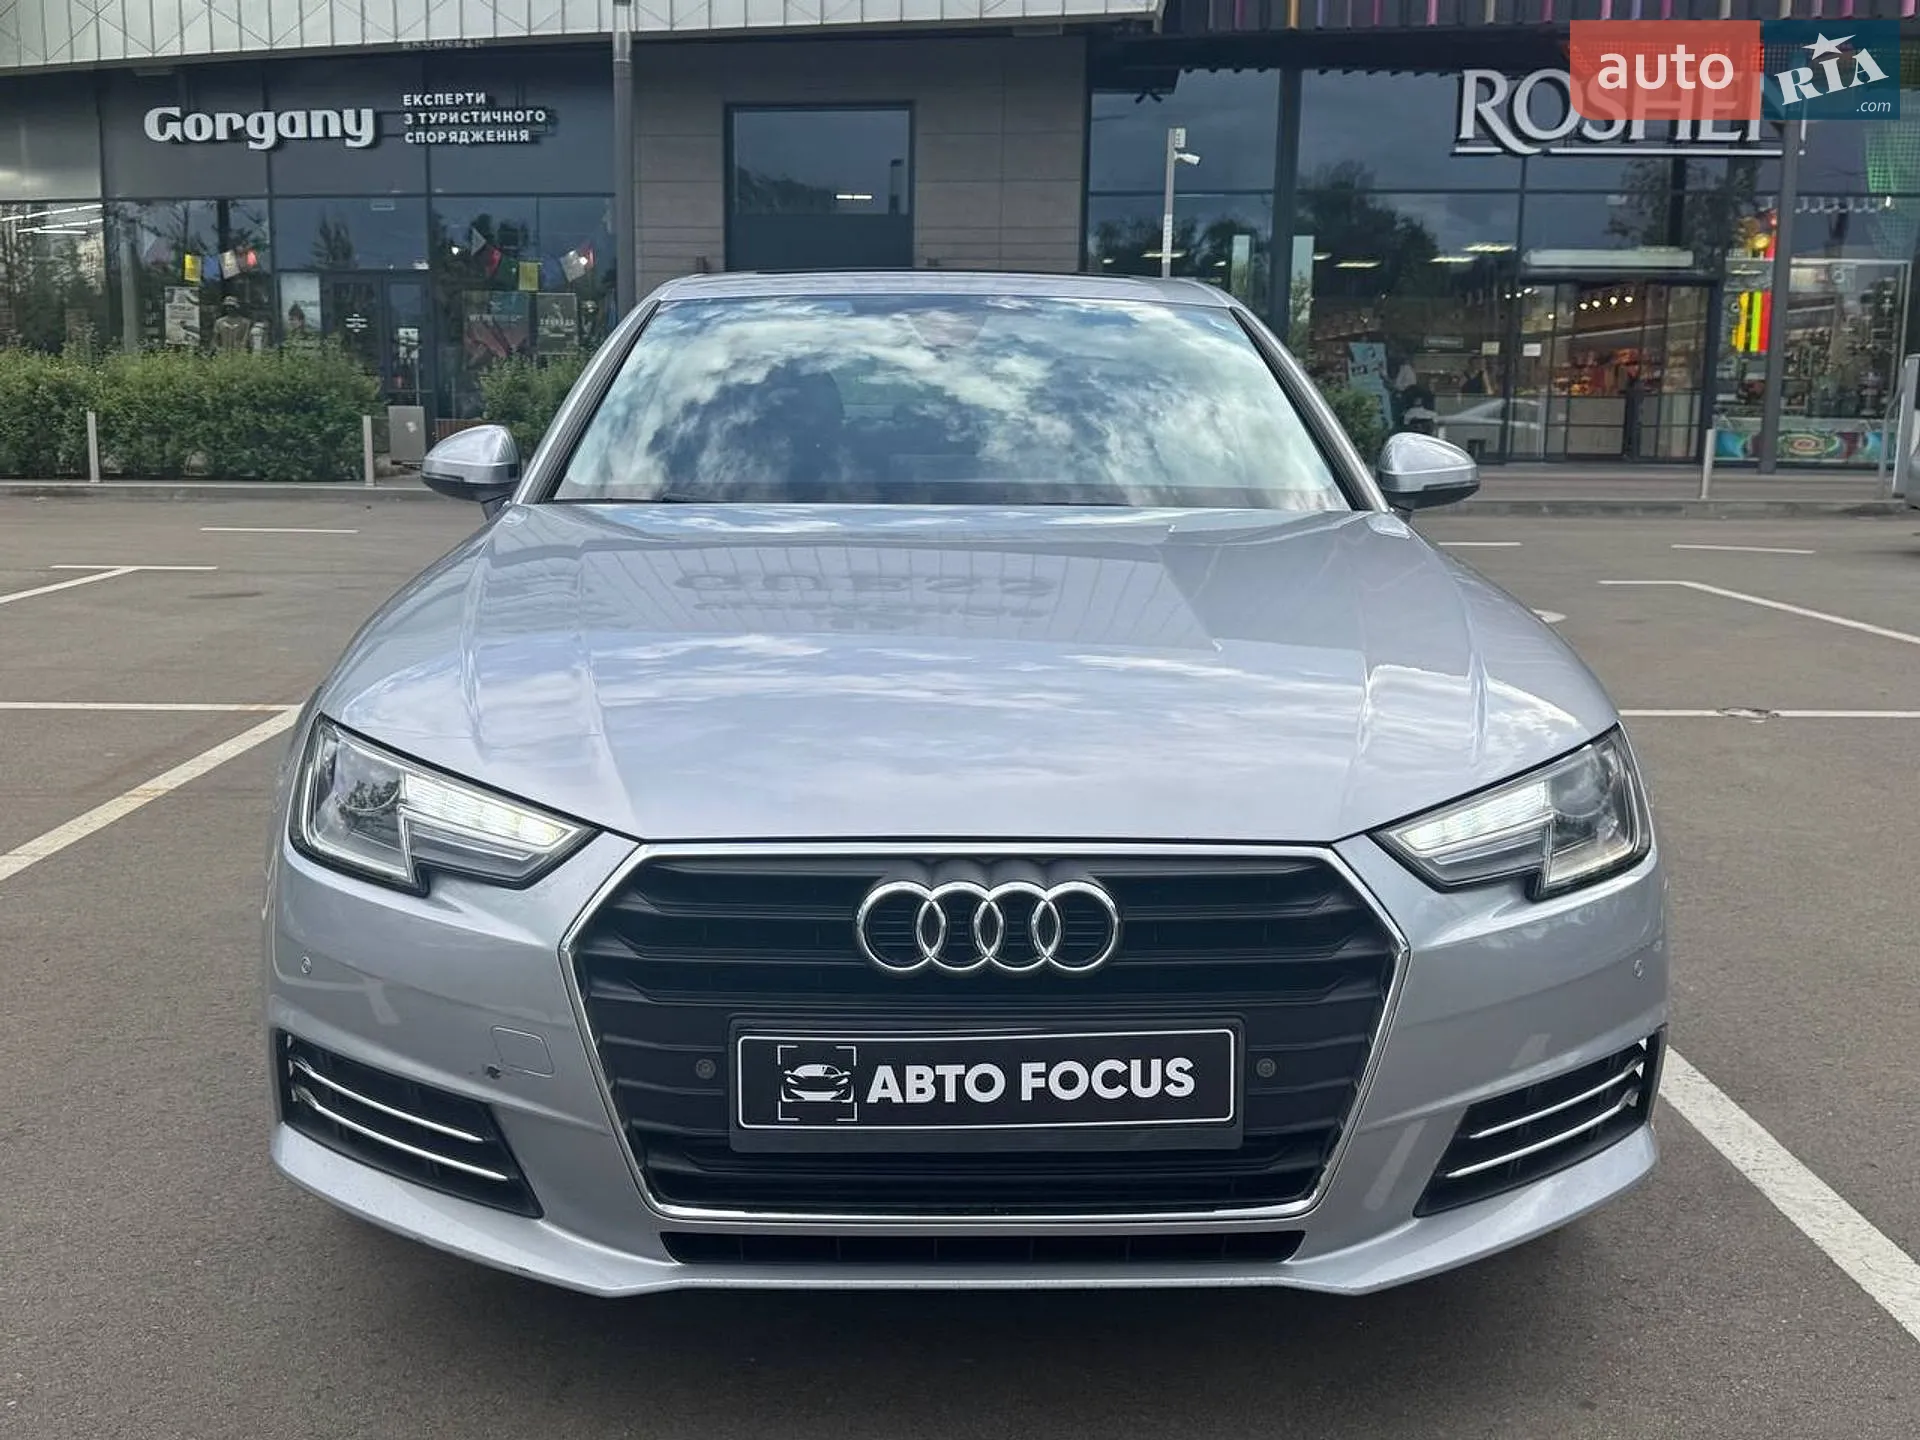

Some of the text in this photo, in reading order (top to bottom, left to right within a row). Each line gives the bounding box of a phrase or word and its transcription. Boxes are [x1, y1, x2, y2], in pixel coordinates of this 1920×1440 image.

[403, 92, 487, 106] ЕКСПЕРТИ
[418, 109, 547, 125] ТУРИСТИЧНОГО
[143, 106, 375, 150] Gorgany
[404, 129, 531, 144] СПОРЯДЖЕННЯ
[1021, 1056, 1196, 1102] FOCUS
